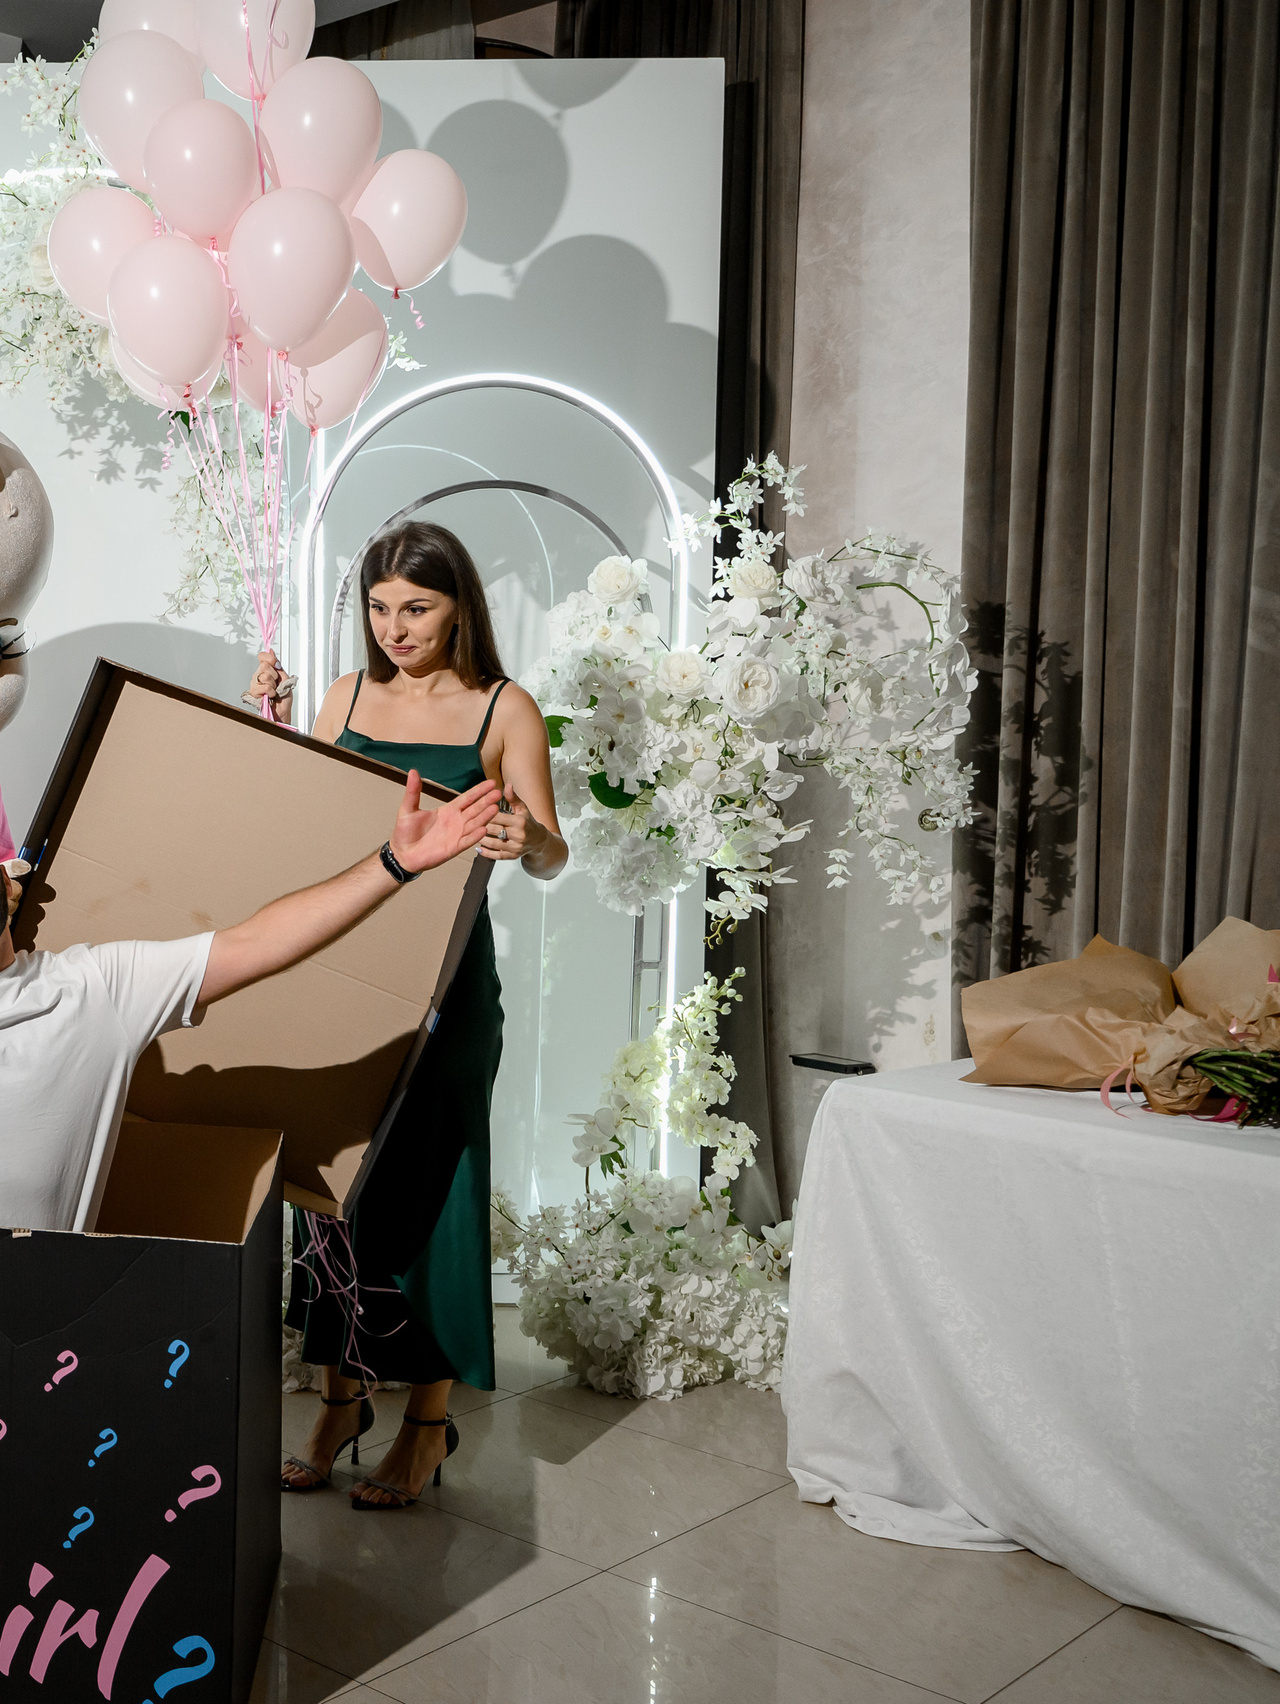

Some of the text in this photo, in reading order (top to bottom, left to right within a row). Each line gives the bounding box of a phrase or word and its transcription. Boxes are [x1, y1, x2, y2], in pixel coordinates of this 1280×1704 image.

[44, 1349, 79, 1393] ?
[164, 1339, 190, 1389] ?
[87, 1427, 118, 1468] ?
[164, 1464, 222, 1523] ?
[63, 1506, 95, 1549] ?
[140, 1635, 216, 1704] ?
